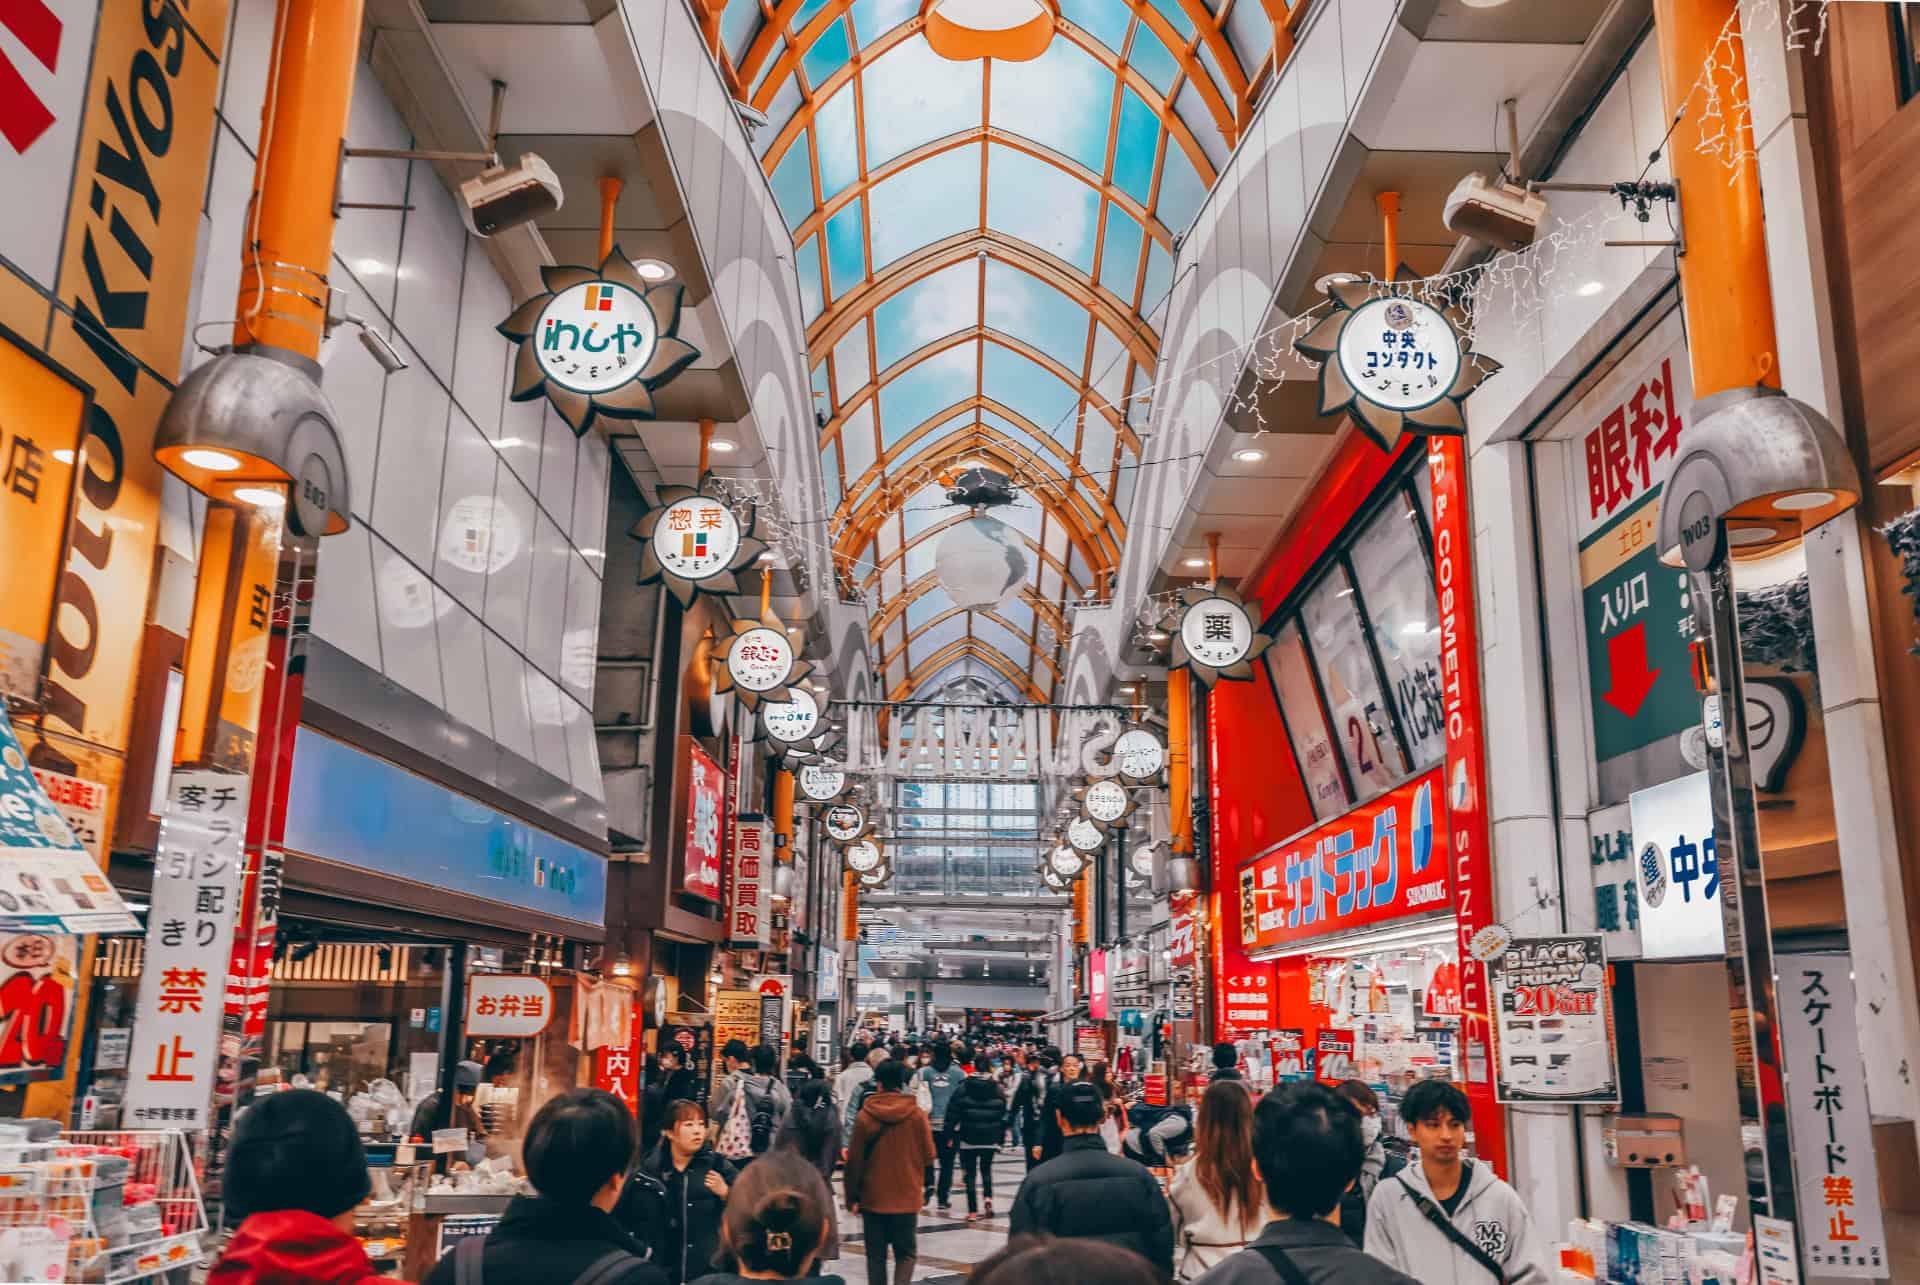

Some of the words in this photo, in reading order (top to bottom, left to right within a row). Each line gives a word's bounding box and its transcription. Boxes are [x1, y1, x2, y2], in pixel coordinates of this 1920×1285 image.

[73, 0, 192, 396] KiYos
[1367, 351, 1437, 370] コンタクト
[1383, 329, 1416, 349] 中央
[551, 355, 626, 378] サンモール
[1363, 371, 1437, 396] サンモール
[1585, 358, 1683, 520] 眼科
[667, 507, 723, 532] 惣菜
[1683, 516, 1710, 550] W03
[1600, 572, 1650, 634] 入り口
[1205, 614, 1233, 640] 薬
[1438, 529, 1463, 741] COSMETIC
[786, 711, 812, 722] ONE
[160, 784, 208, 948] 客引き
[194, 786, 237, 948] チラシ配り
[736, 827, 761, 936] 高価買取
[1286, 806, 1398, 929] サンドラッグ
[1505, 941, 1586, 969] BLACK
[1228, 975, 1268, 988] くすり
[146, 966, 208, 1082] 禁止
[475, 994, 545, 1018] お弁当
[607, 1044, 630, 1100] 内入
[1801, 970, 1859, 1241] スケートボード禁止
